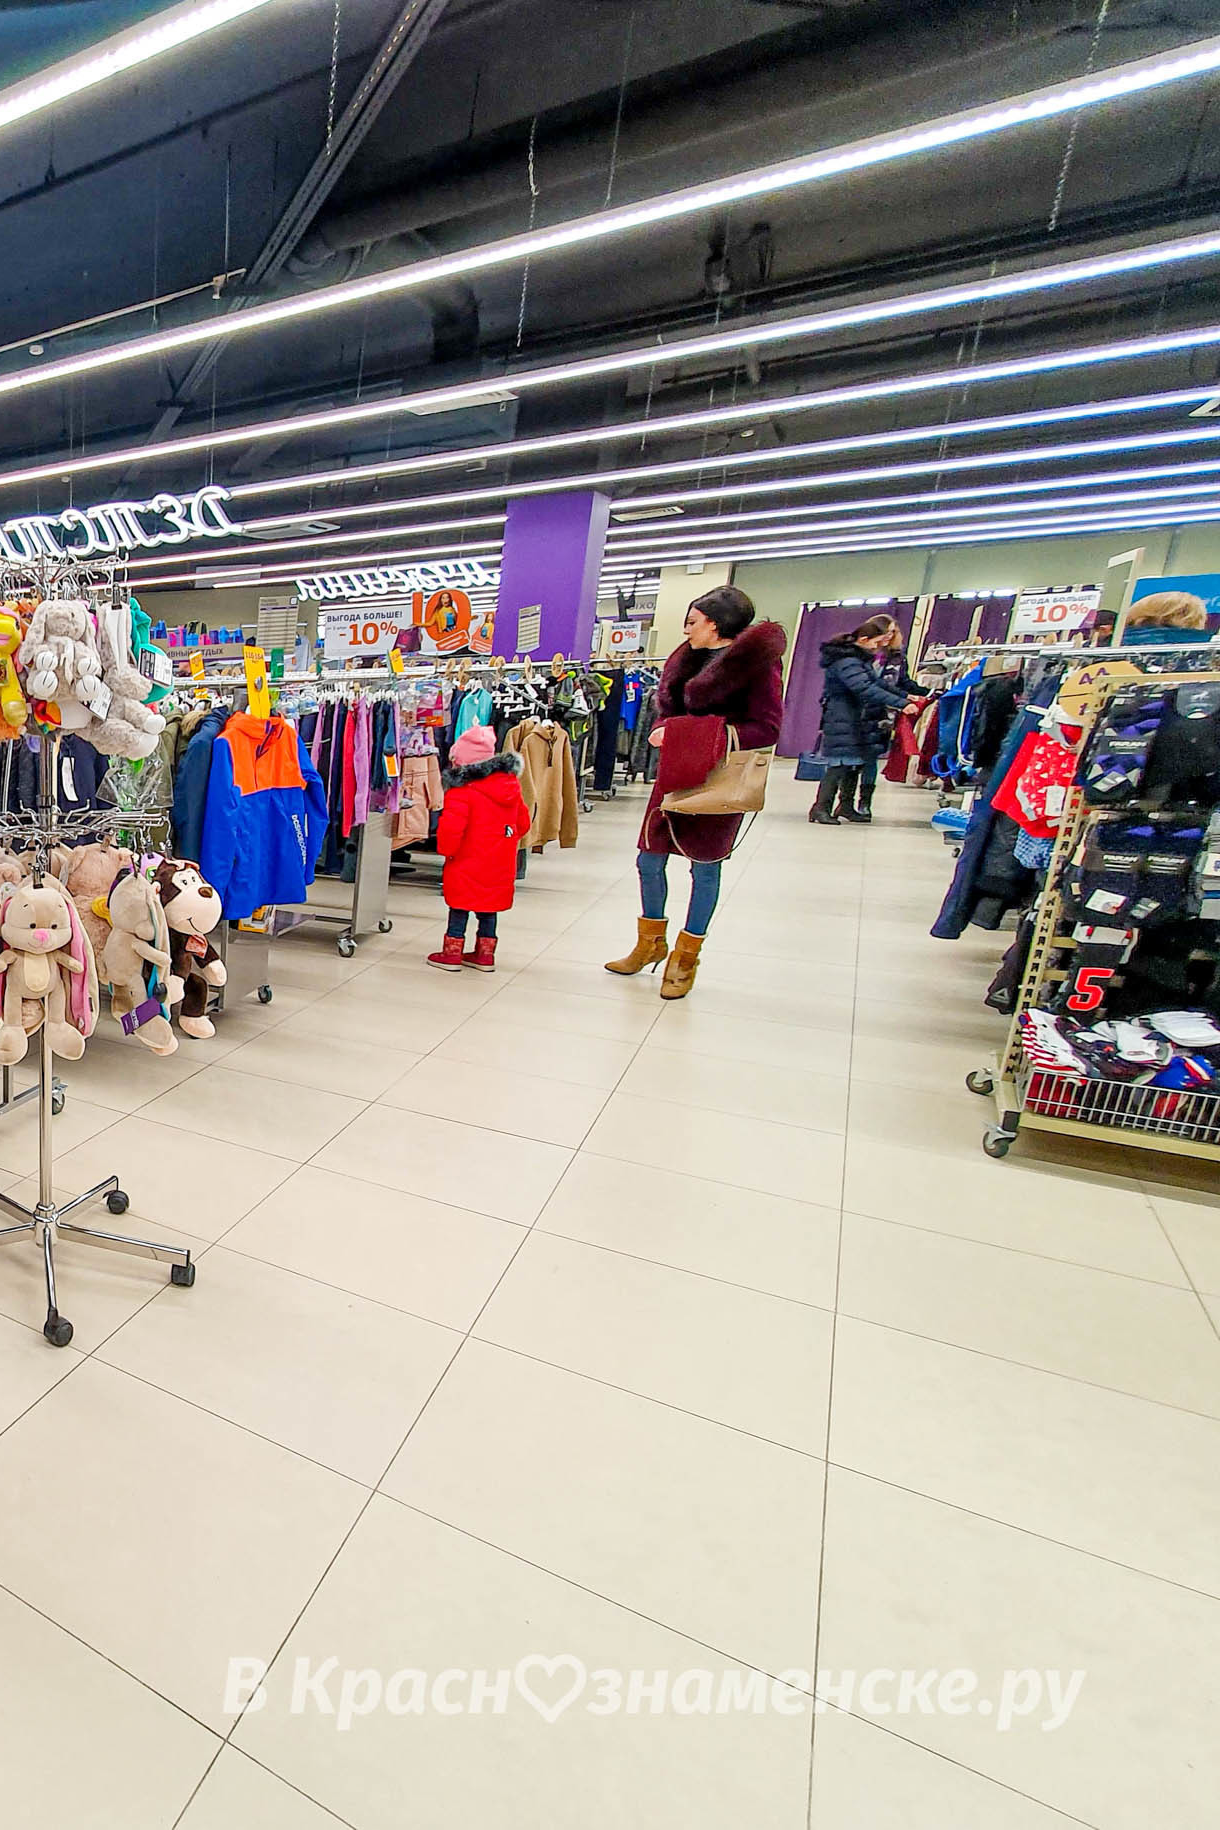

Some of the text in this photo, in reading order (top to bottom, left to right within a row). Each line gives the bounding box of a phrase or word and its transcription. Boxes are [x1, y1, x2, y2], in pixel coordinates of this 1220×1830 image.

[327, 610, 403, 622] ВЫГОДА БОЛЬШЕ!
[1023, 603, 1088, 623] -10%
[339, 621, 398, 646] -10%
[197, 647, 223, 657] тдых
[1066, 967, 1115, 1011] 5
